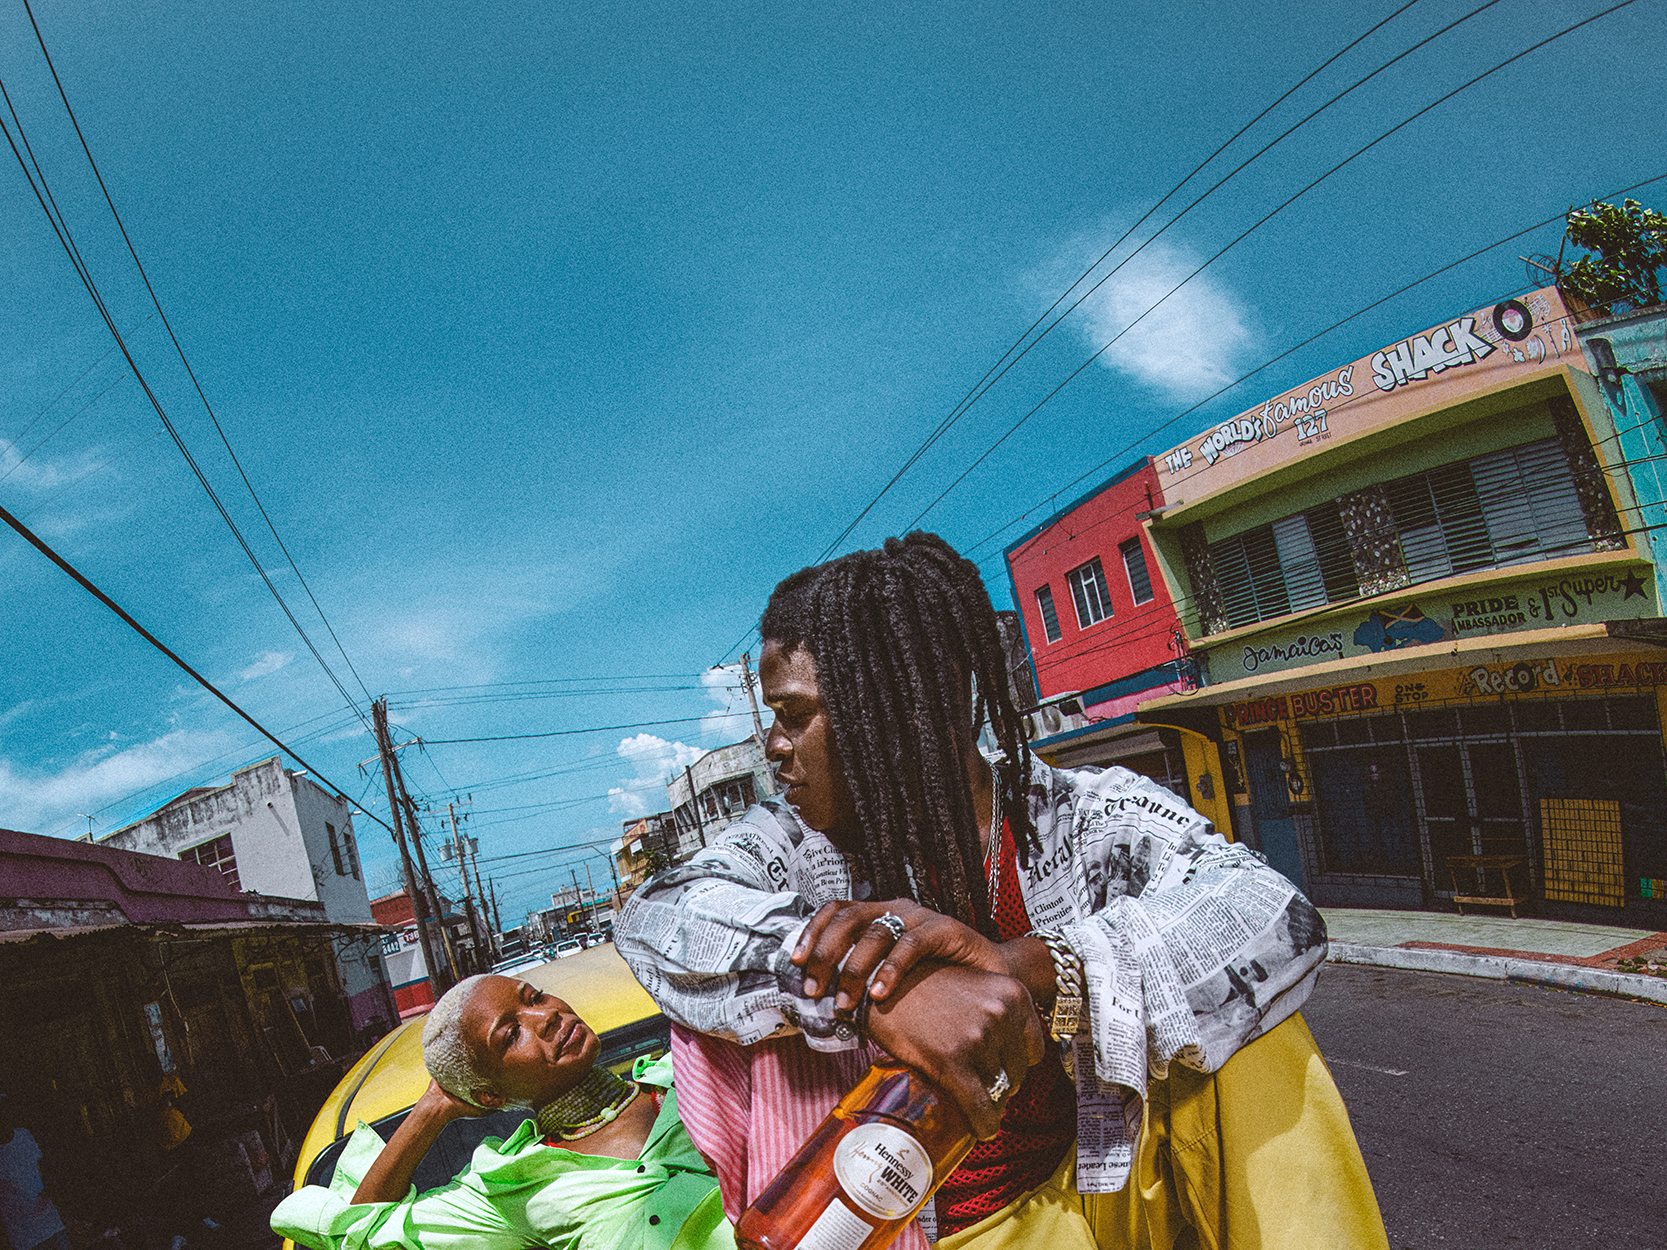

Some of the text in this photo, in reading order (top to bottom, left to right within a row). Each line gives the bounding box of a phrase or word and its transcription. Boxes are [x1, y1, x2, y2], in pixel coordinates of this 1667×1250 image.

[1164, 446, 1194, 475] THE
[1371, 316, 1498, 392] SHACK
[1294, 408, 1329, 441] 127
[1451, 594, 1520, 619] PRIDE
[1558, 574, 1622, 618] Super
[1451, 612, 1527, 636] AMBASSADOR
[1223, 658, 1667, 727] PRINCE BUSTER ONE Record SHACK
[1394, 691, 1430, 704] STOP
[1033, 895, 1065, 916] Clinton
[1035, 904, 1074, 931] Priorities
[875, 1143, 914, 1180] Hennessy
[1078, 1162, 1106, 1171] Leader
[860, 1182, 884, 1203] COGNAC
[880, 1165, 919, 1204] WHITE
